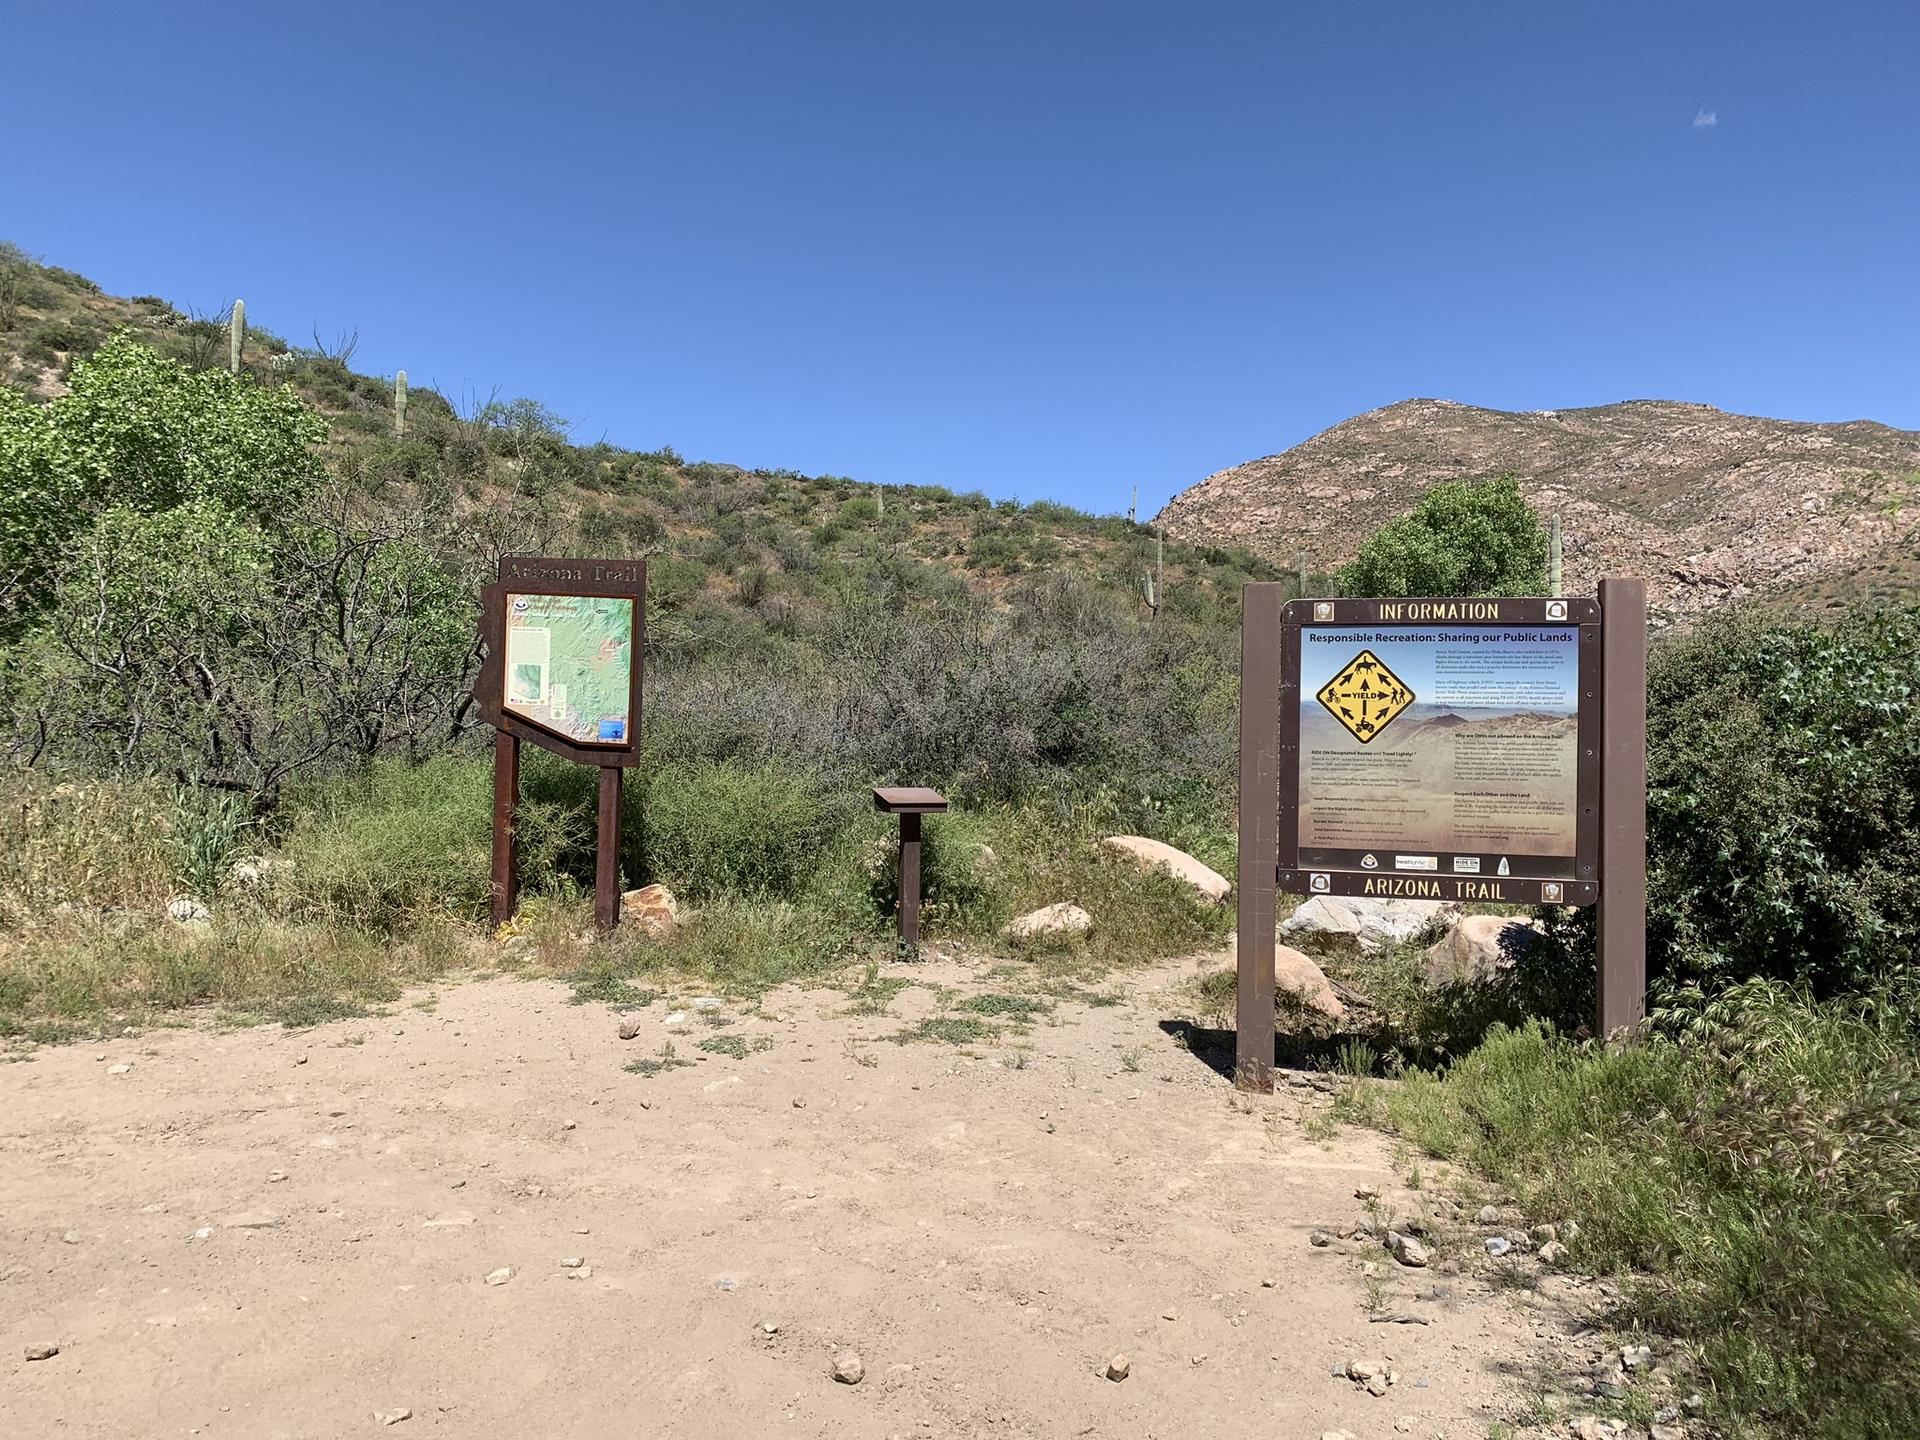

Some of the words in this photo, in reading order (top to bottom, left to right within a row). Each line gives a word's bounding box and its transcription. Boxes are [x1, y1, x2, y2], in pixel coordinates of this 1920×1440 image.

[507, 563, 582, 580] Arizona
[590, 564, 638, 582] Trail
[1379, 602, 1499, 620] INFORMATION
[1309, 633, 1373, 644] Responsible
[1375, 633, 1436, 643] Recreation:
[1438, 632, 1480, 644] Sharing
[1503, 632, 1539, 643] Public
[1540, 632, 1573, 643] Lands
[1364, 878, 1442, 897] ARIZONA
[1455, 881, 1506, 900] TRAIL
